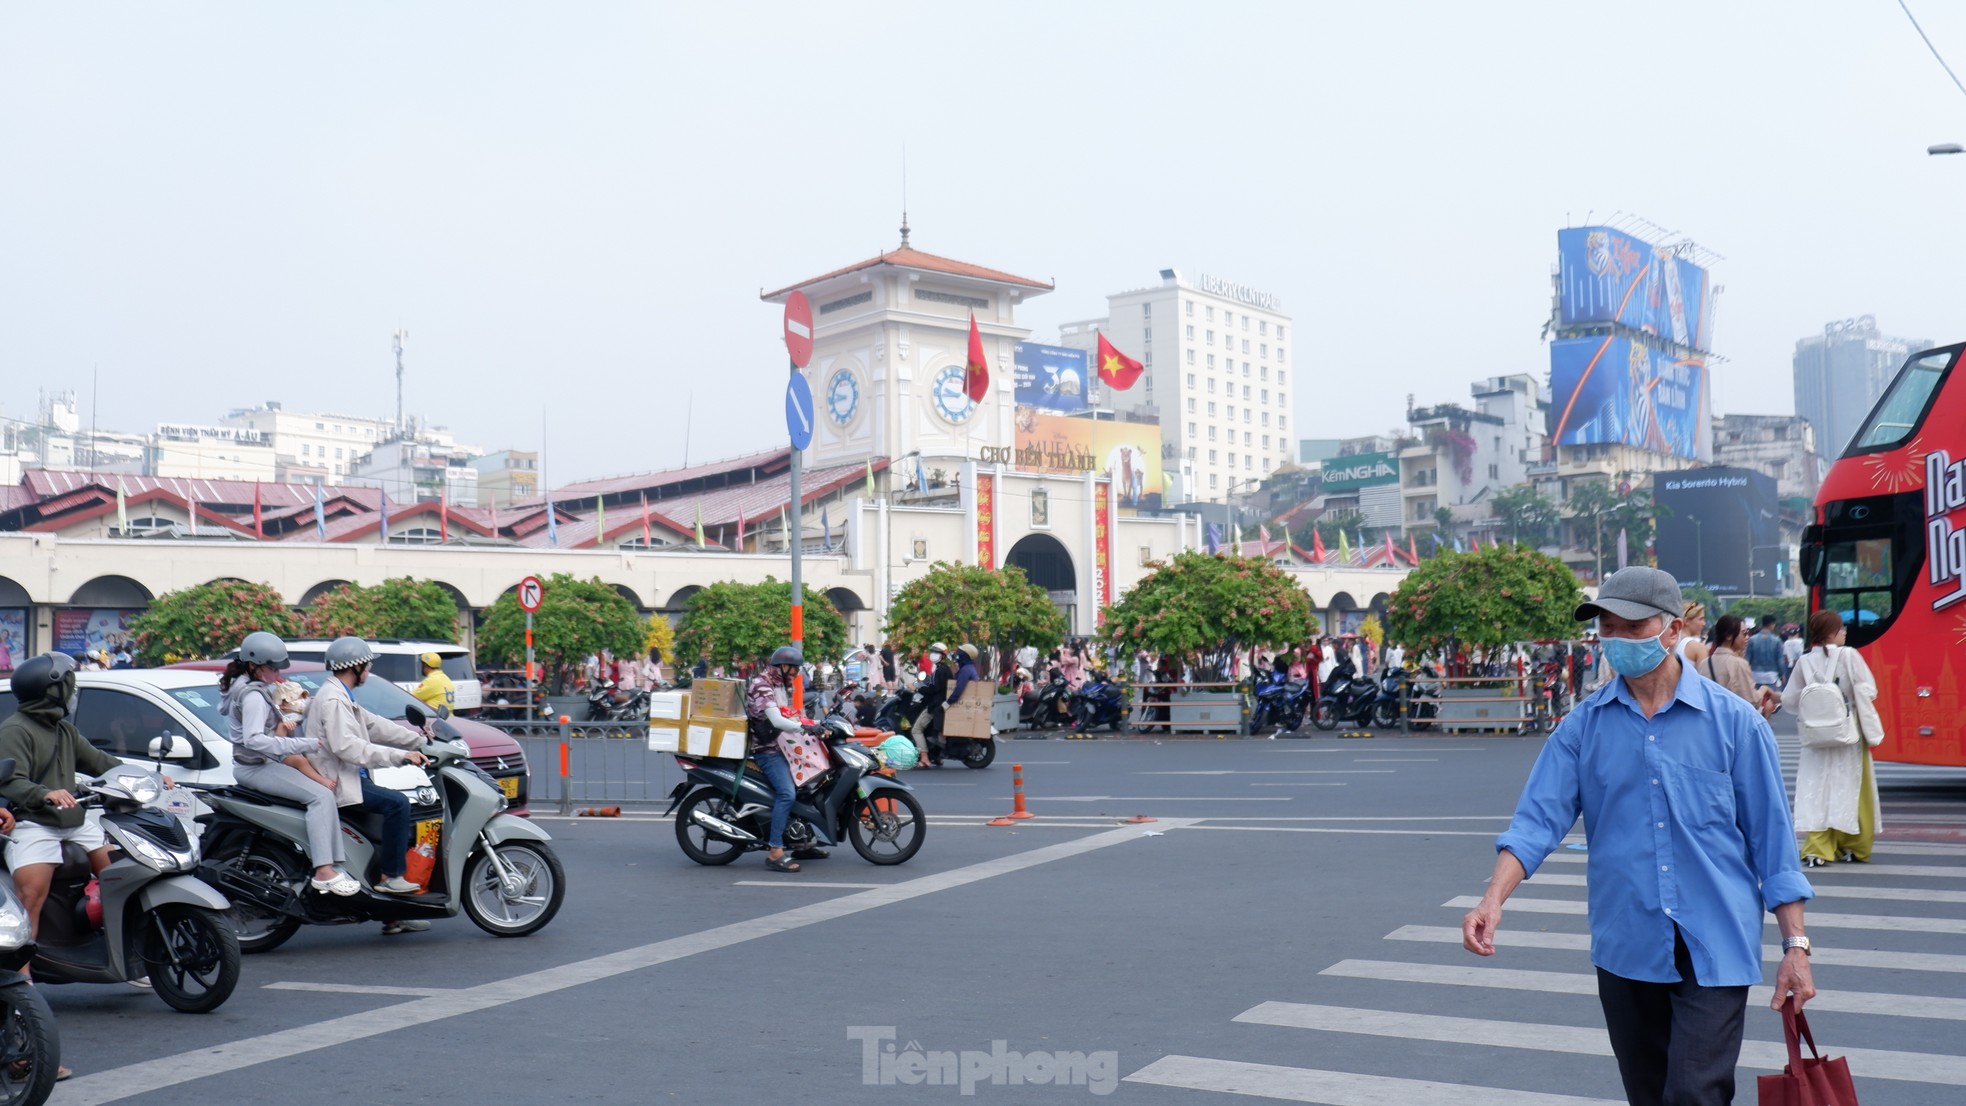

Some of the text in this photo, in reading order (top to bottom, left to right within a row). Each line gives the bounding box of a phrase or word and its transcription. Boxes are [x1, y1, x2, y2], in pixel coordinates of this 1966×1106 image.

[1201, 273, 1238, 298] LIBERTY
[980, 446, 1011, 465] CHỢ
[1665, 475, 1747, 491] Kia Sorento Hybrid
